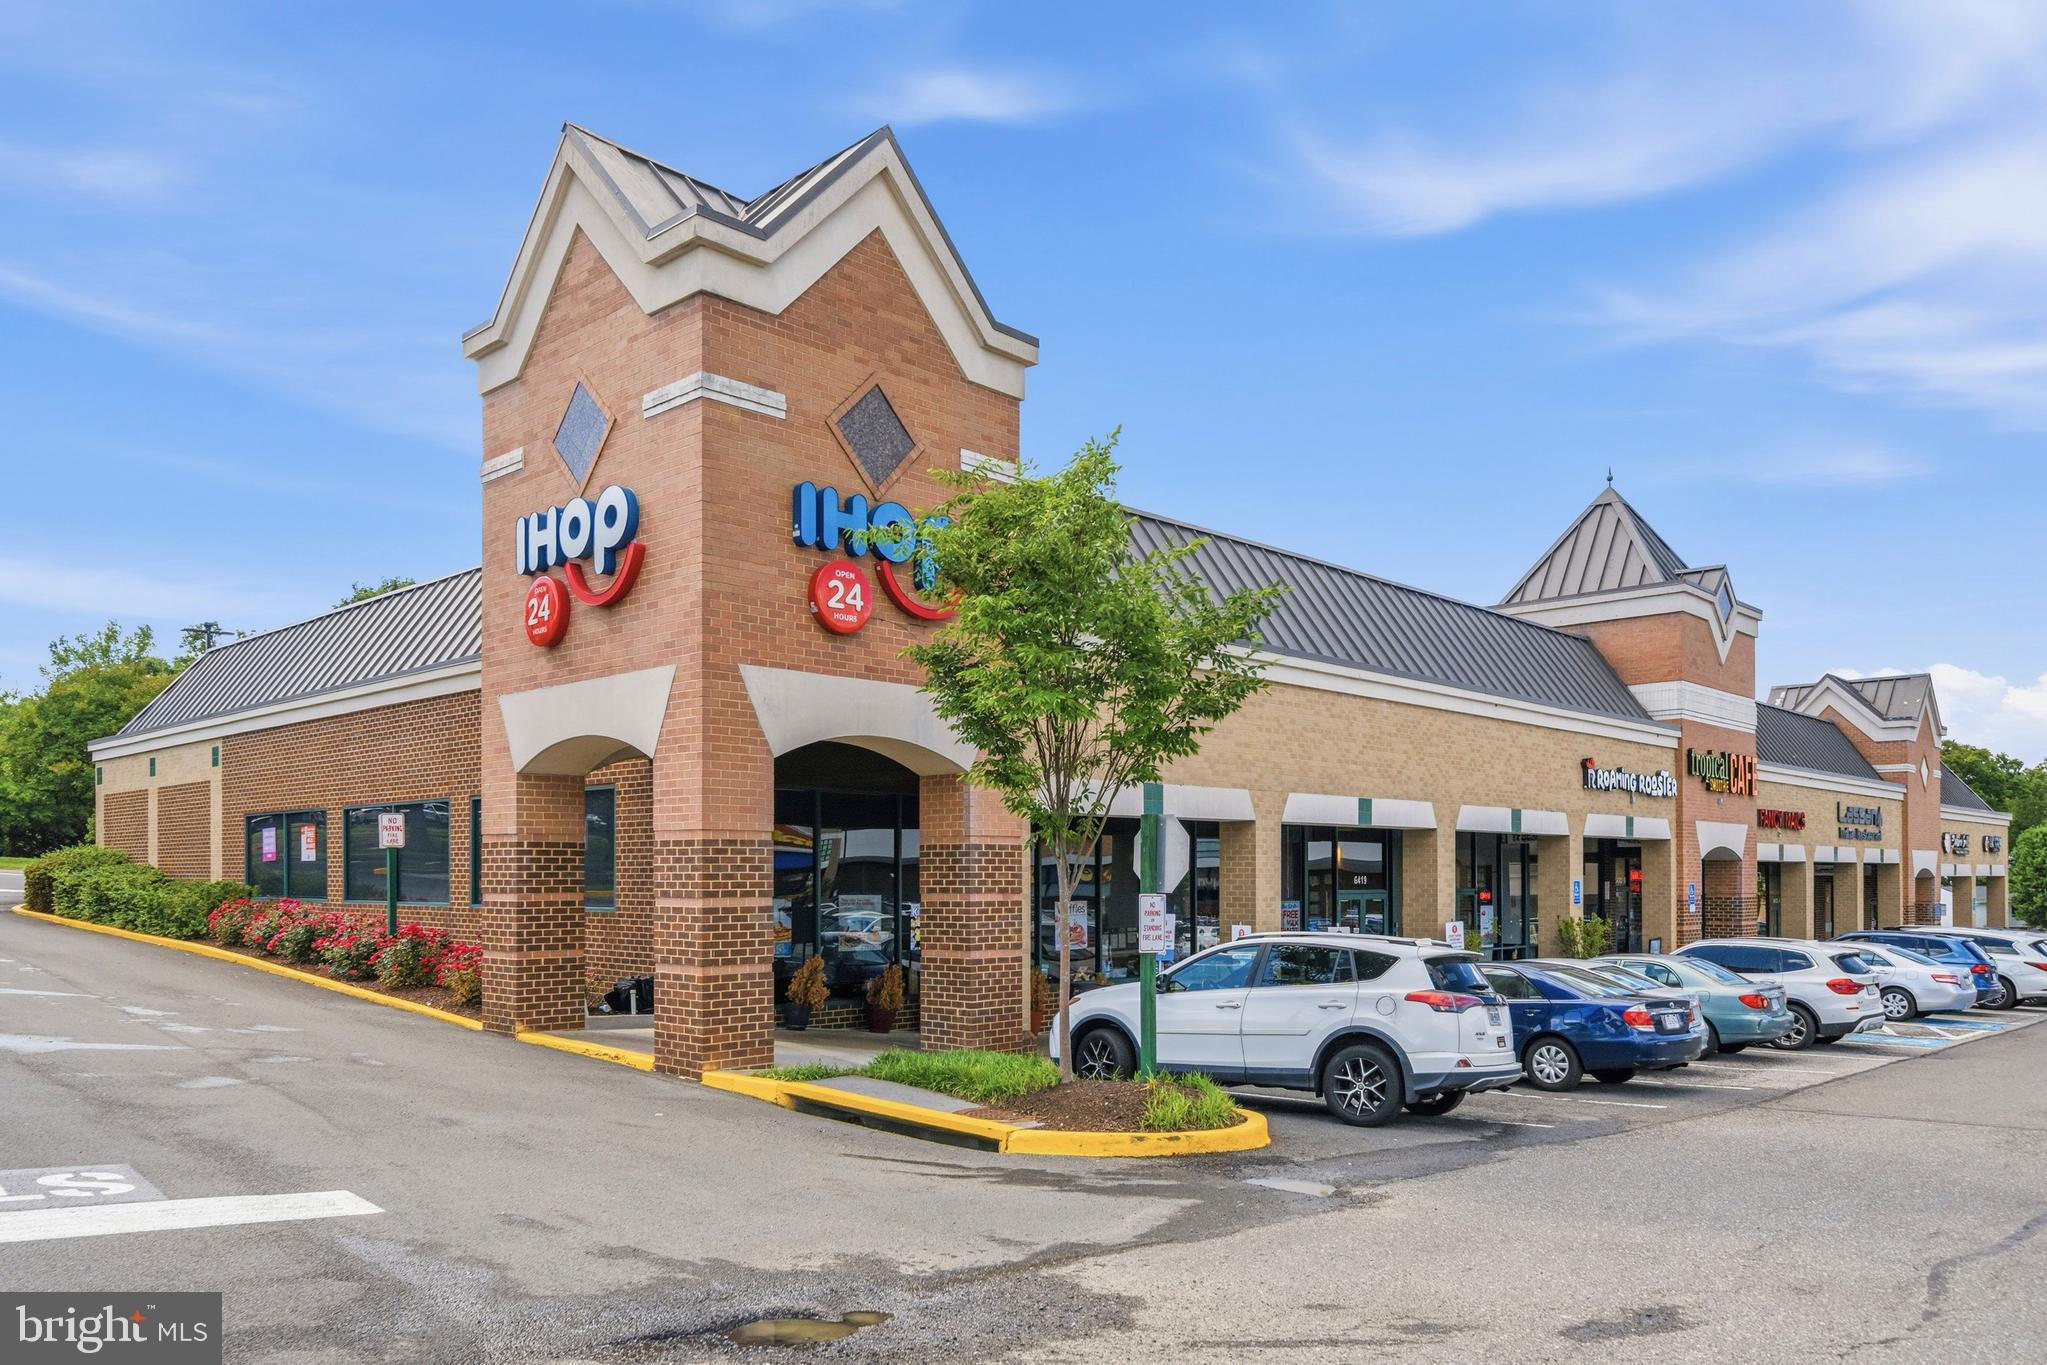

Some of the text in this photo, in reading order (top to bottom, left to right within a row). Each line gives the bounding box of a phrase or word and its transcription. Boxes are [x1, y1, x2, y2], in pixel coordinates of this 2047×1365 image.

[515, 484, 639, 576] IHOP
[836, 569, 855, 580] OPEN
[527, 593, 551, 626] 24
[827, 579, 864, 612] 24
[532, 626, 548, 636] HOURS
[834, 613, 858, 623] HOURS
[1690, 748, 1730, 783] tropical
[1730, 753, 1758, 796] CAFE
[1596, 767, 1677, 797] ROAMING ROOSTER
[1353, 875, 1368, 885] 6419
